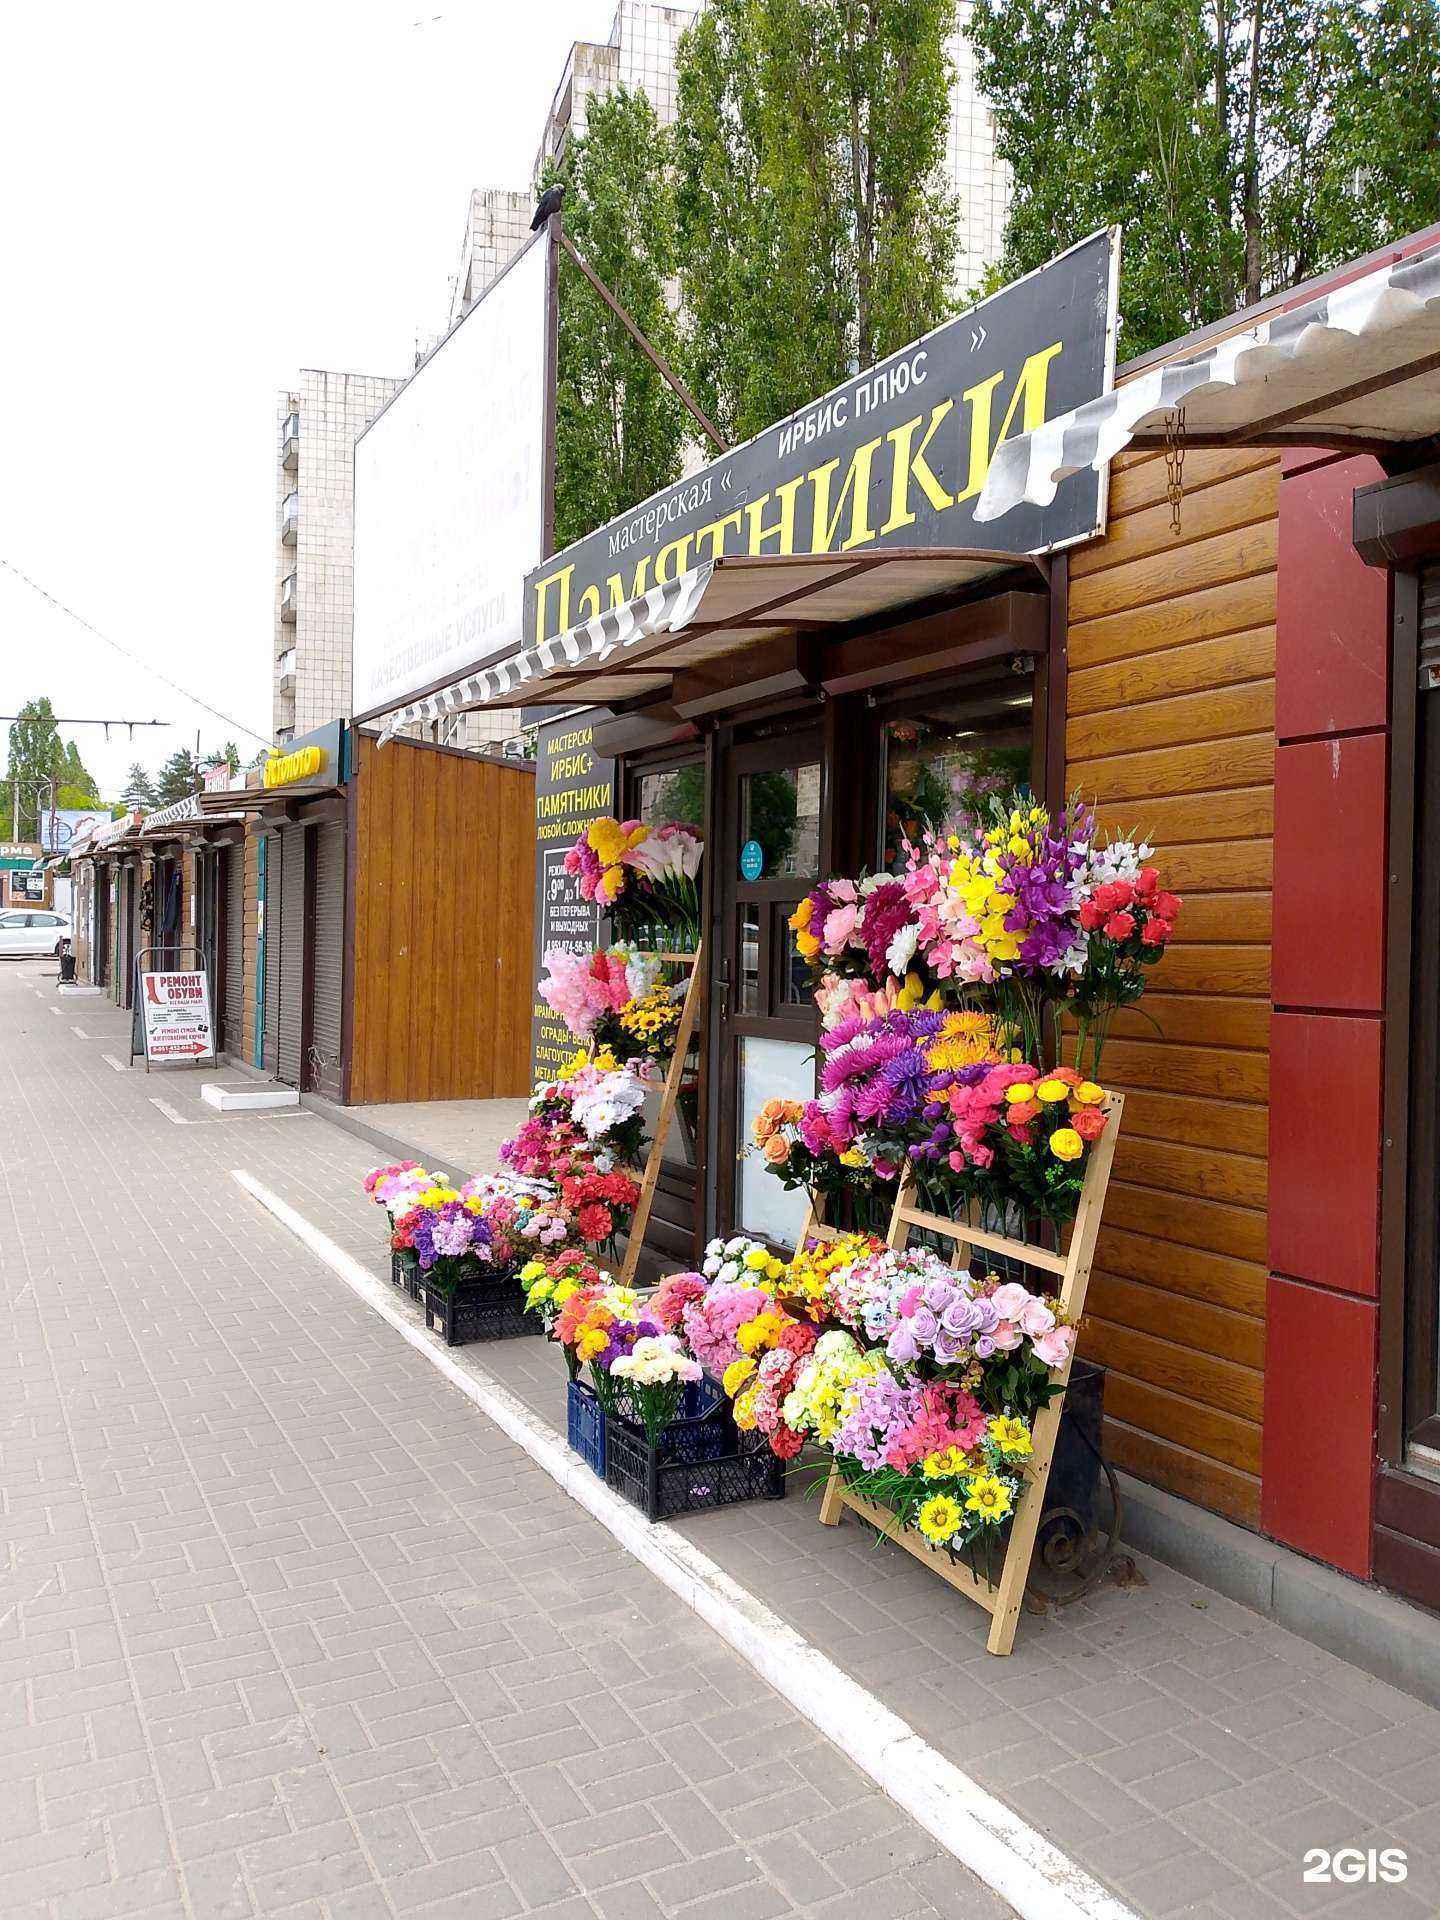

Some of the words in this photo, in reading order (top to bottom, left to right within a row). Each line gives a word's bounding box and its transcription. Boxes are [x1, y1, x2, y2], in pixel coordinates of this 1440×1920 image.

[609, 476, 713, 558] мастерская
[778, 397, 848, 459] ИРБИС
[855, 351, 928, 418] ПЛЮС
[547, 727, 593, 755] МАСТЕРСКА
[537, 783, 611, 819] ПАМЯТНИКИ
[537, 818, 561, 840] ЛЮБОЙ
[549, 906, 559, 917] БЕЗ
[560, 905, 591, 917] ПЕРЕРЫВА
[556, 920, 589, 935] ВЫХОДНЫХ
[160, 976, 201, 988] РЕМОНТ
[168, 987, 203, 999] ОБУВИ
[541, 1026, 569, 1045] ОГРАДЫ
[535, 1066, 556, 1082] МЕТАЛ
